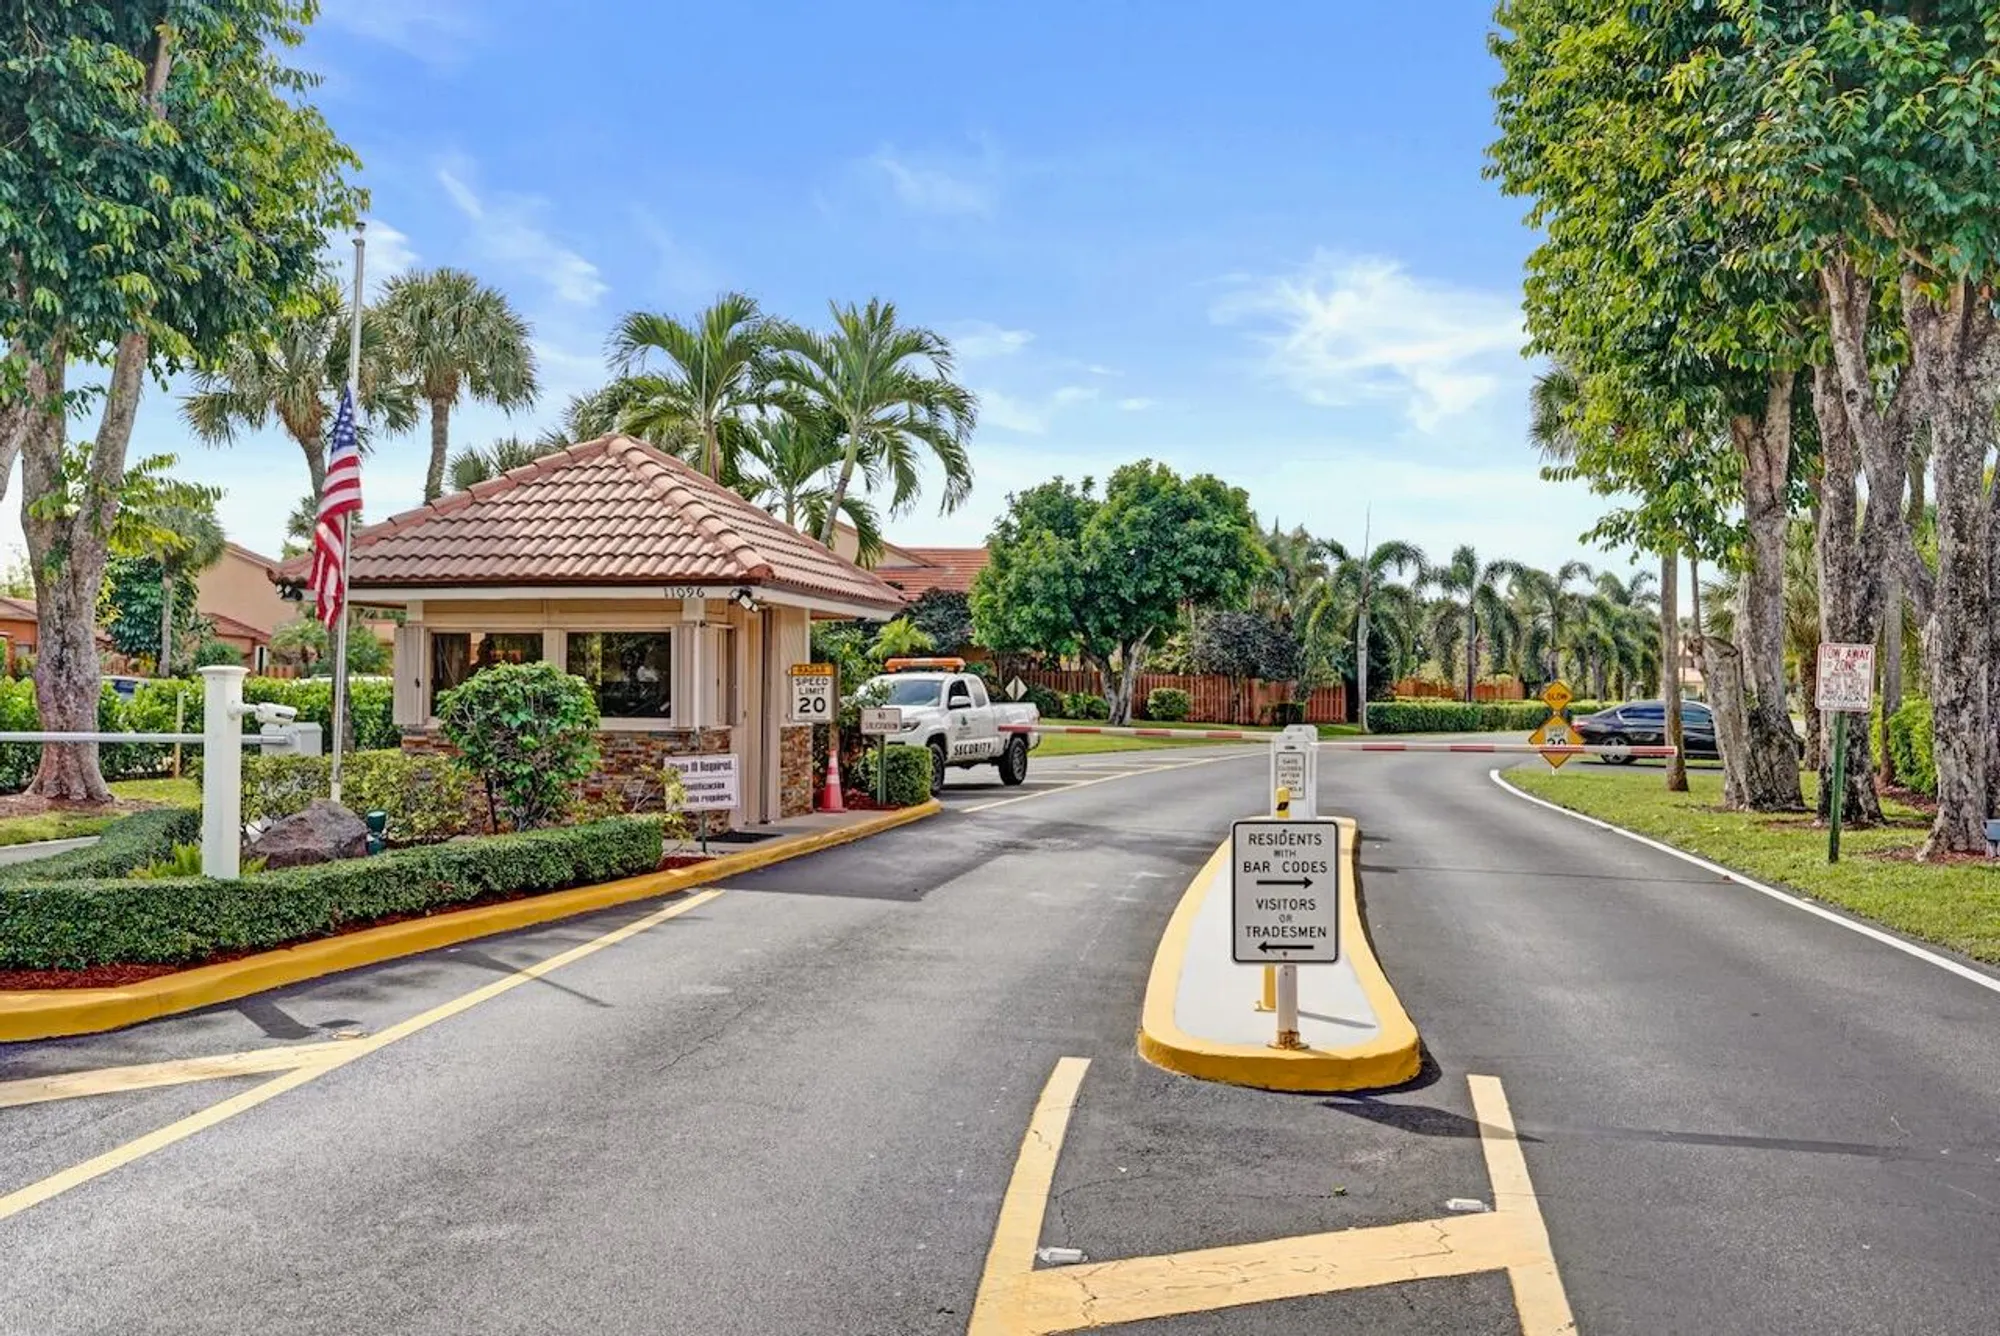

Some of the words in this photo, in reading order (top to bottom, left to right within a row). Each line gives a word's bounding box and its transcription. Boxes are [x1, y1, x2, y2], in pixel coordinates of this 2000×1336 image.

[663, 586, 705, 599] 11096
[795, 678, 828, 686] SPEED
[798, 687, 825, 695] LIMIT
[798, 696, 826, 713] 20
[954, 742, 992, 756] SECURITY
[1248, 833, 1323, 846] RESIDENTS
[1273, 849, 1297, 858] WITH
[1243, 861, 1271, 873] BAR
[1281, 861, 1328, 873] CODES
[1256, 898, 1317, 911] VISITORS
[1278, 913, 1293, 922] OR
[1245, 926, 1327, 938] TRADESMEN
